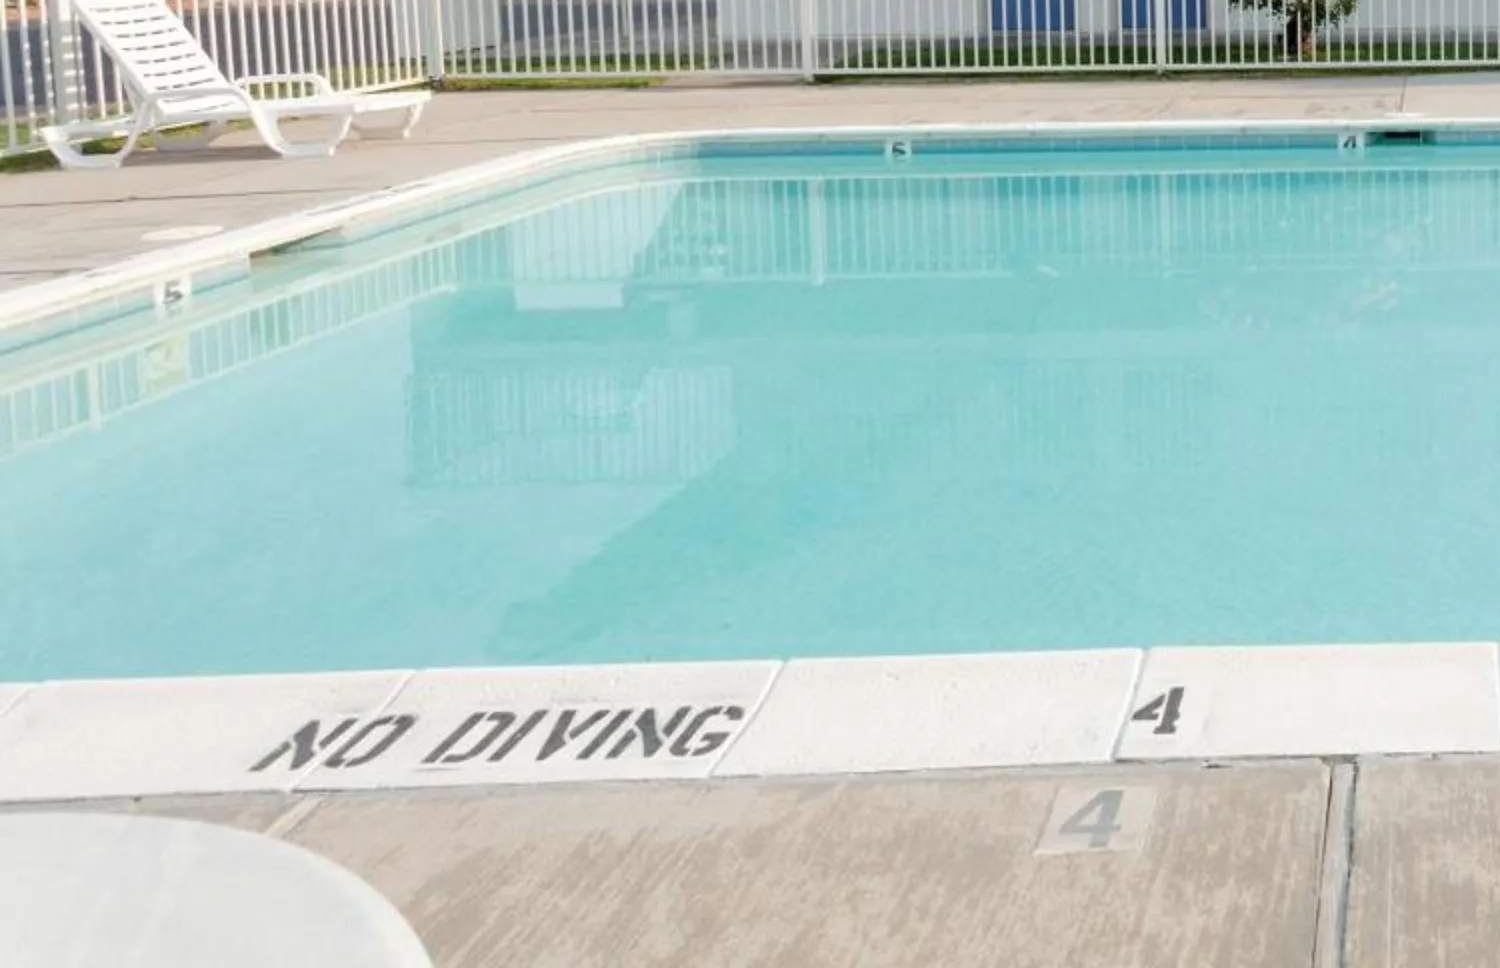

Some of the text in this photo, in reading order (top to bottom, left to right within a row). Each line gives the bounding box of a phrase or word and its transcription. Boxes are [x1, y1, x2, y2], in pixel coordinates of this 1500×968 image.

[163, 280, 184, 304] 5
[1132, 686, 1185, 734] 4
[250, 704, 744, 772] NO DIVING
[1057, 788, 1127, 848] 4
